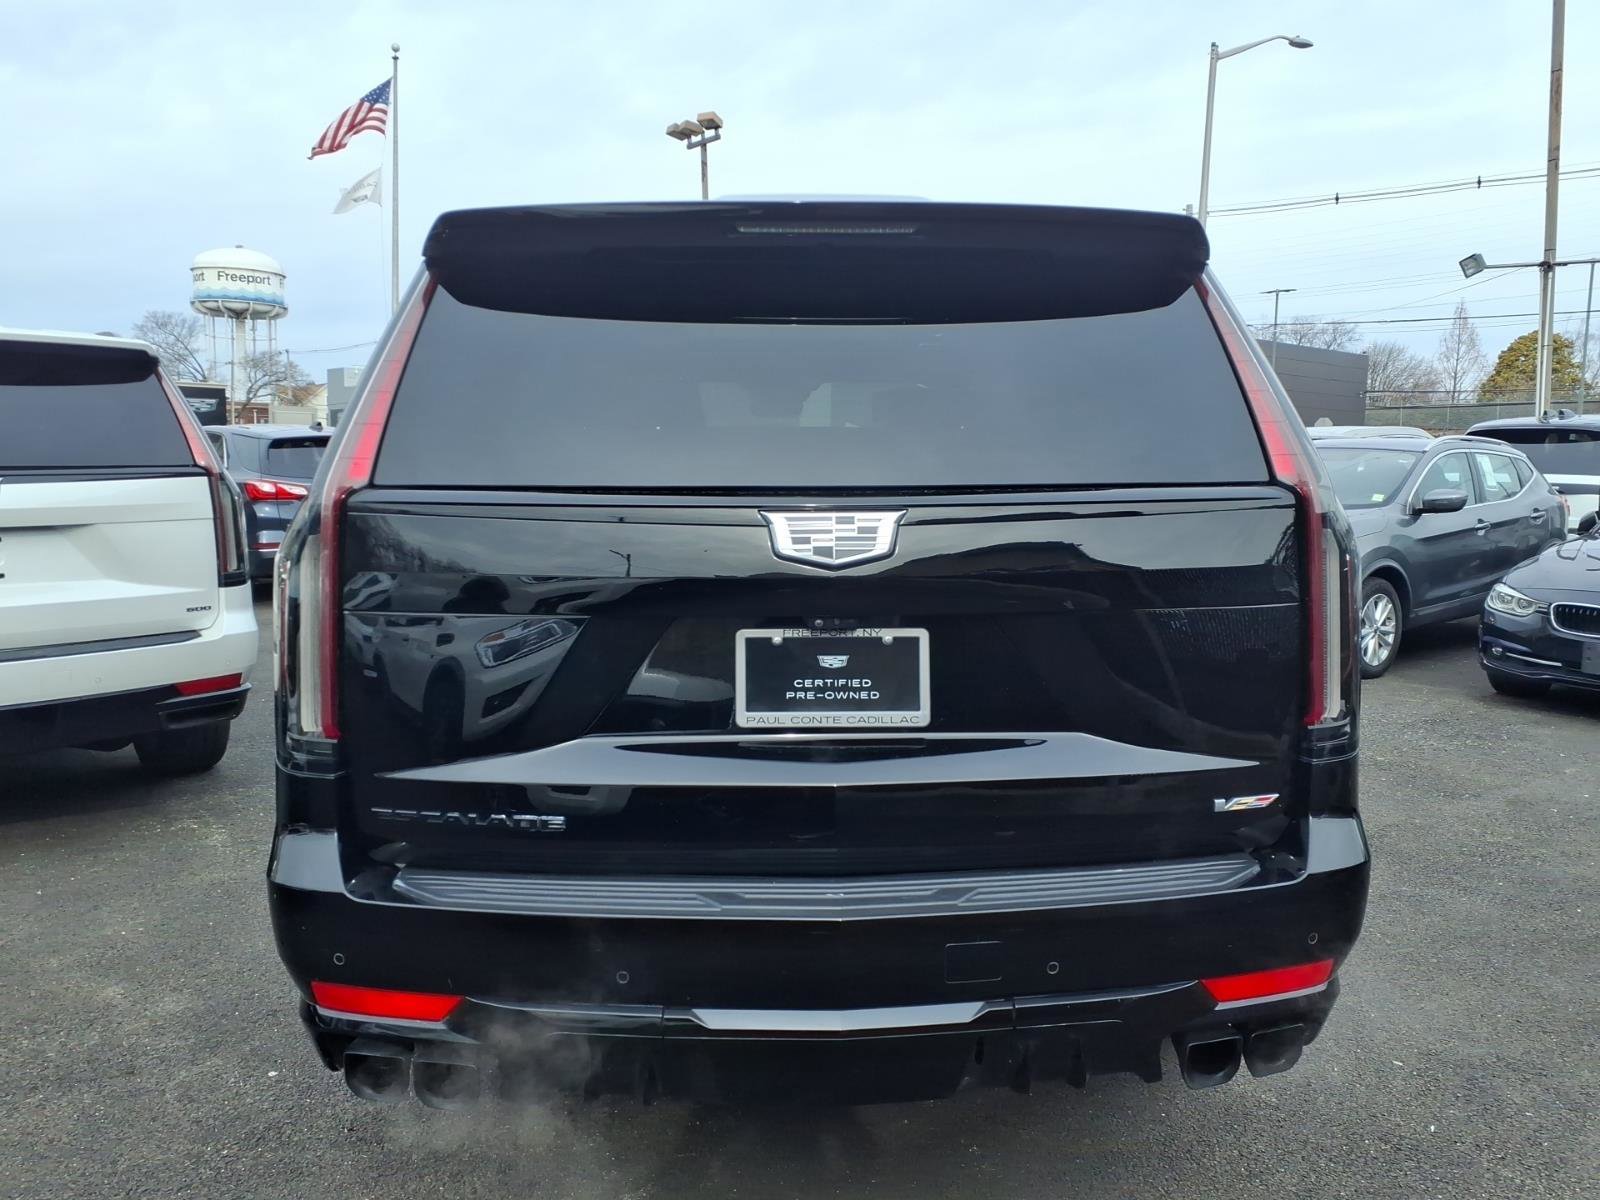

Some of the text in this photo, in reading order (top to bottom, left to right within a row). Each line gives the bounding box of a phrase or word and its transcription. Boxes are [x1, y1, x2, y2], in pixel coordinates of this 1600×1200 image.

[217, 270, 271, 285] Freeport
[793, 679, 872, 688] CERTIFIED
[786, 691, 880, 700] PRE-OWNED
[746, 716, 920, 725] PAUL CONTE CADILLAC
